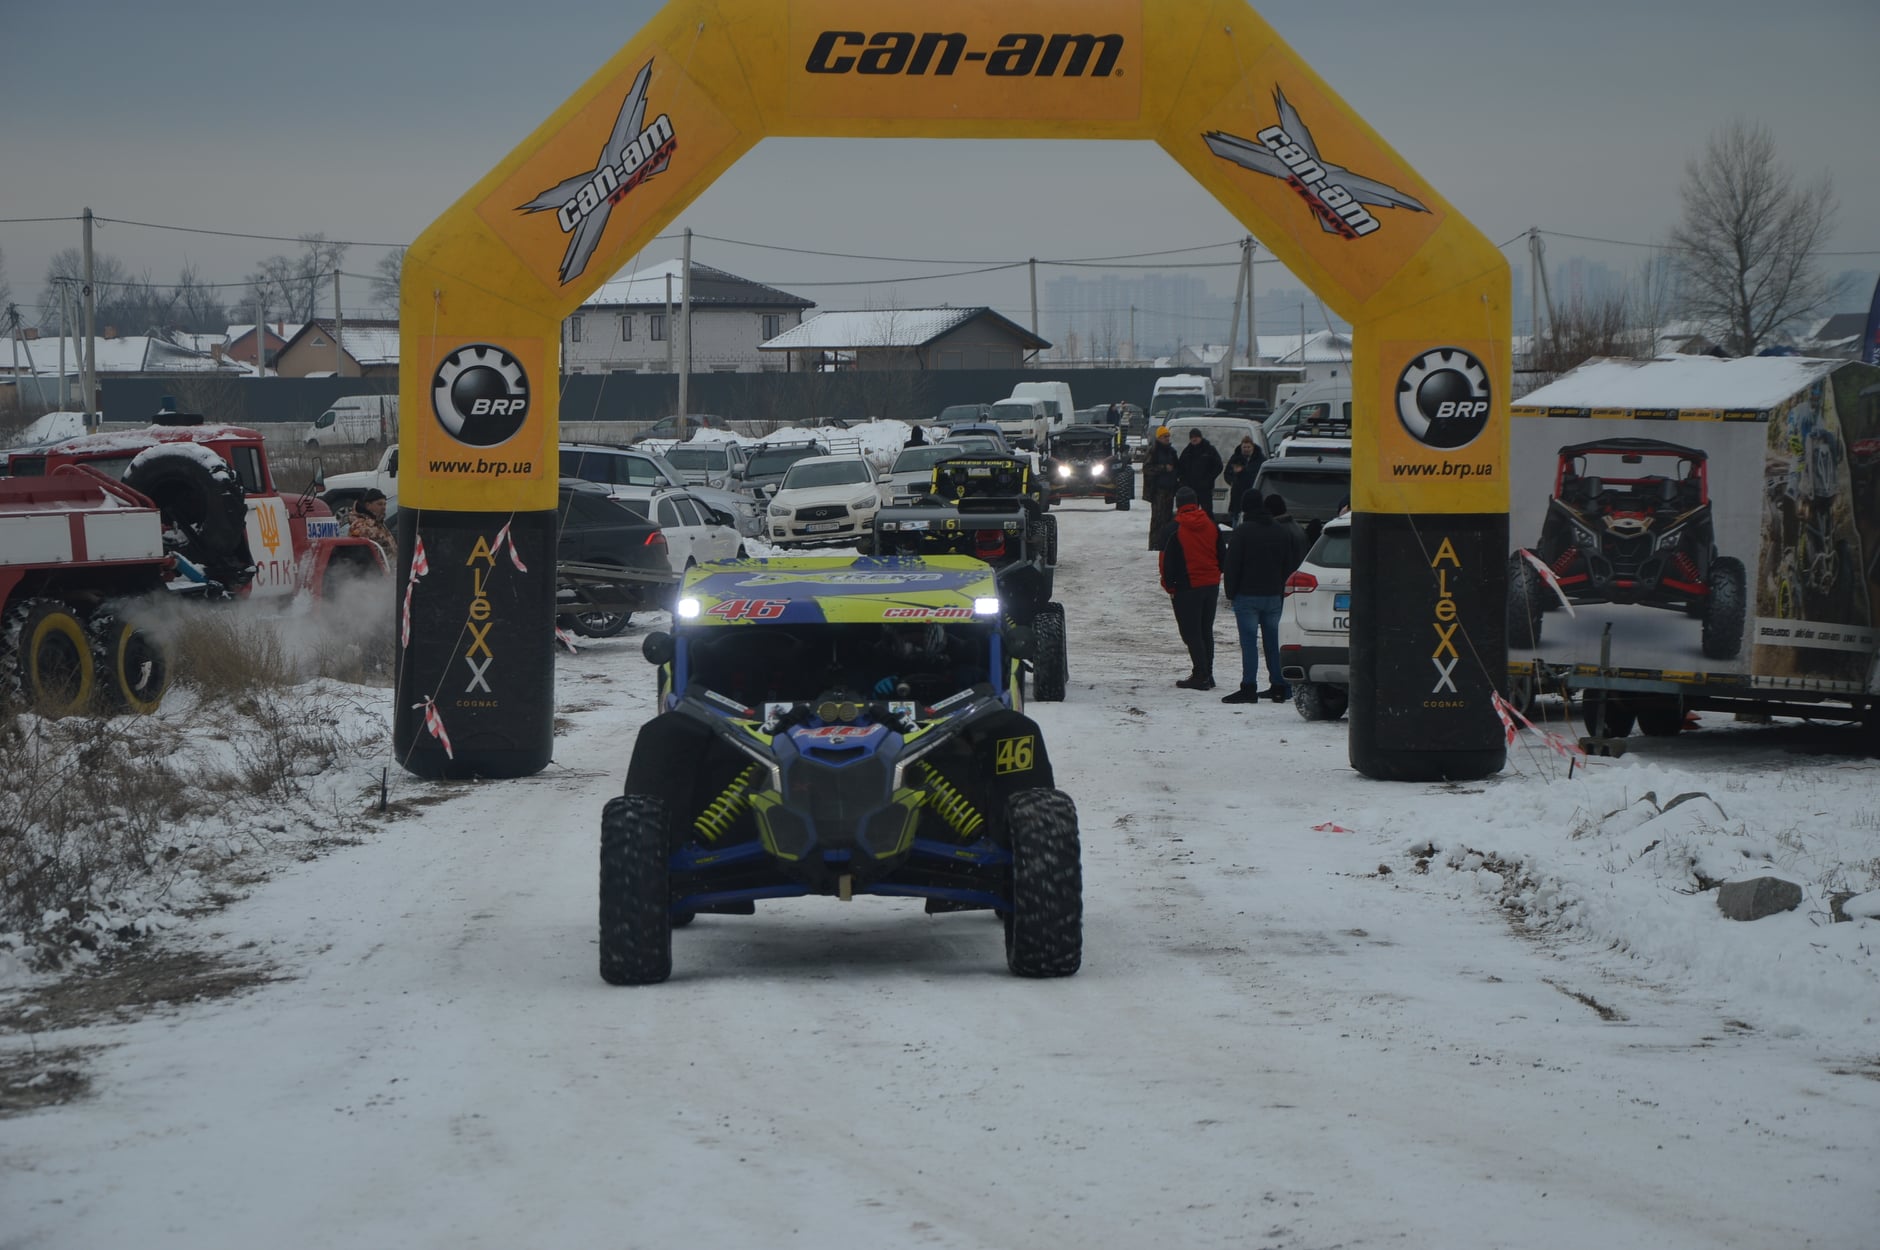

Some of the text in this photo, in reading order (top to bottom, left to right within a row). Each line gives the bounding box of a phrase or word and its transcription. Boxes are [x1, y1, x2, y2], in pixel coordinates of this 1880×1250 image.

[805, 31, 1124, 77] can-am
[557, 113, 675, 233] can-am
[1256, 124, 1381, 237] can-am
[470, 398, 526, 415] BRP
[1435, 401, 1488, 418] BRP
[429, 458, 532, 476] www.brp.ua
[1392, 460, 1493, 479] www.brp.ua
[945, 519, 956, 530] 6
[705, 598, 791, 620] 46
[882, 607, 974, 618] can-am
[456, 700, 499, 708] COGNAC
[1423, 700, 1465, 708] COGNAC
[998, 737, 1032, 771] 46
